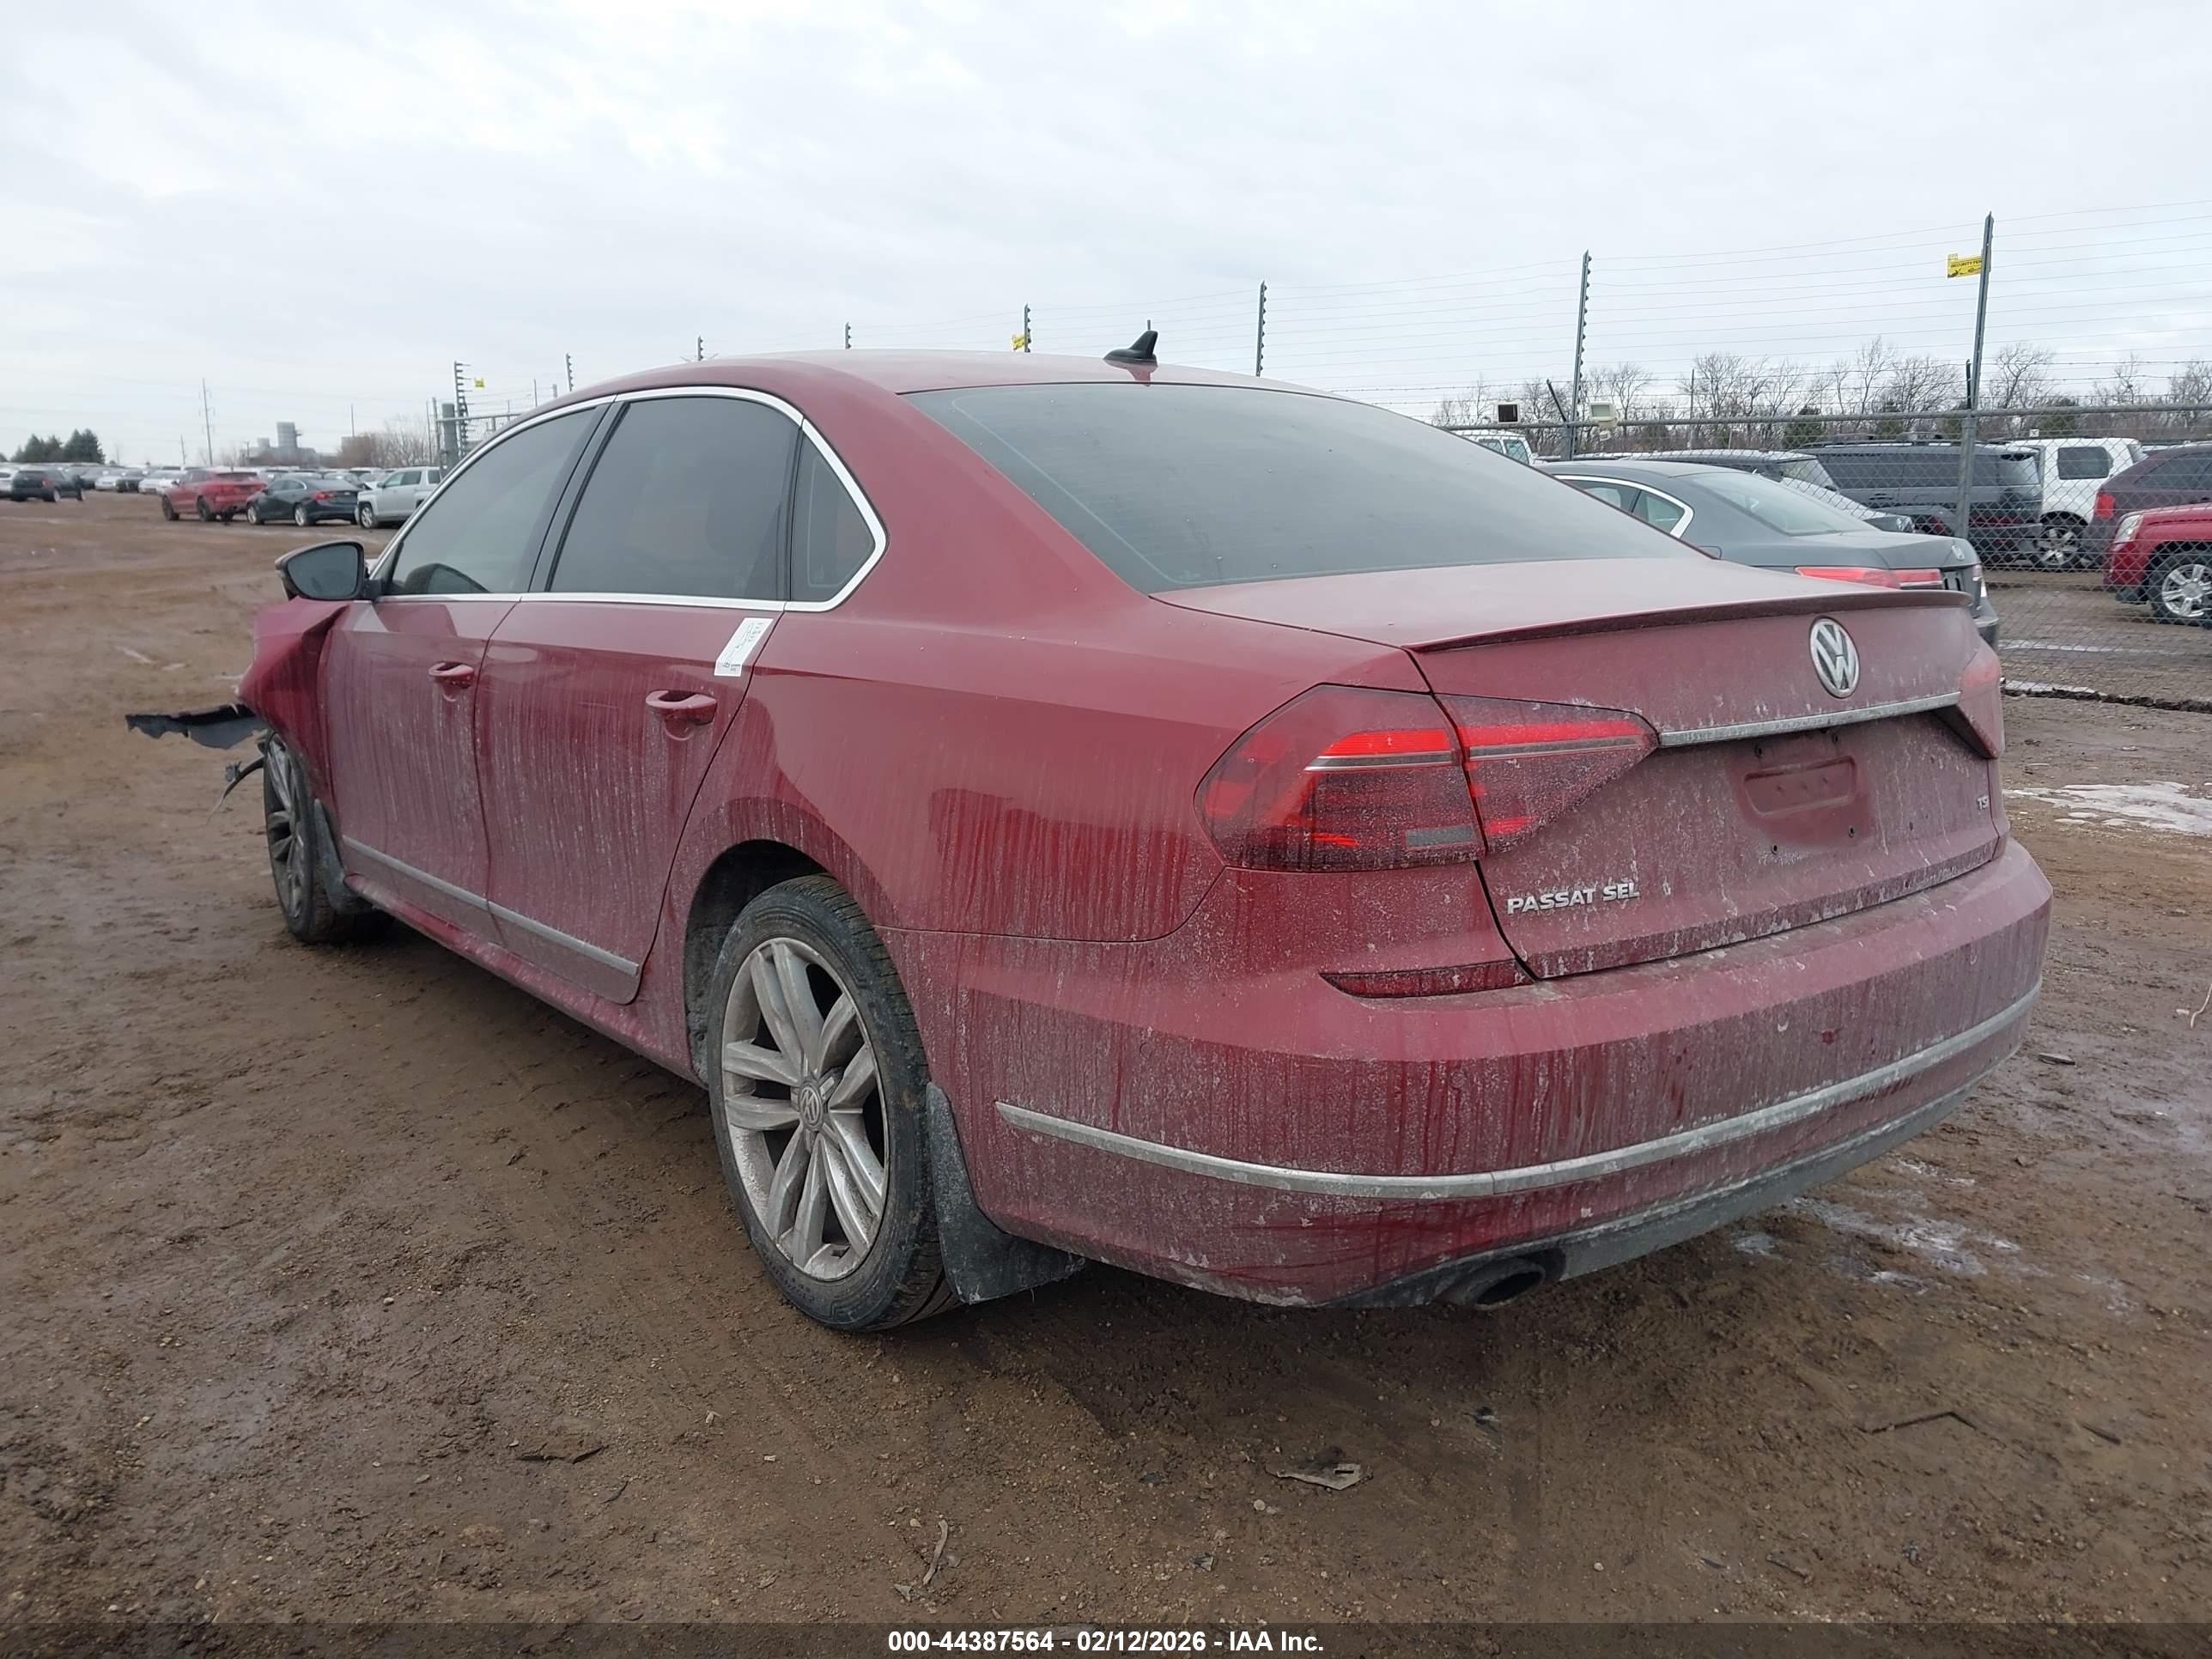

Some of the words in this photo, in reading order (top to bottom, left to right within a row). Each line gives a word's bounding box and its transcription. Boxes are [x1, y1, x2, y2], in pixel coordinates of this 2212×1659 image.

[1809, 617, 1860, 698] VW
[1507, 888, 1596, 915] PASSAT
[1602, 882, 1640, 902] SEL
